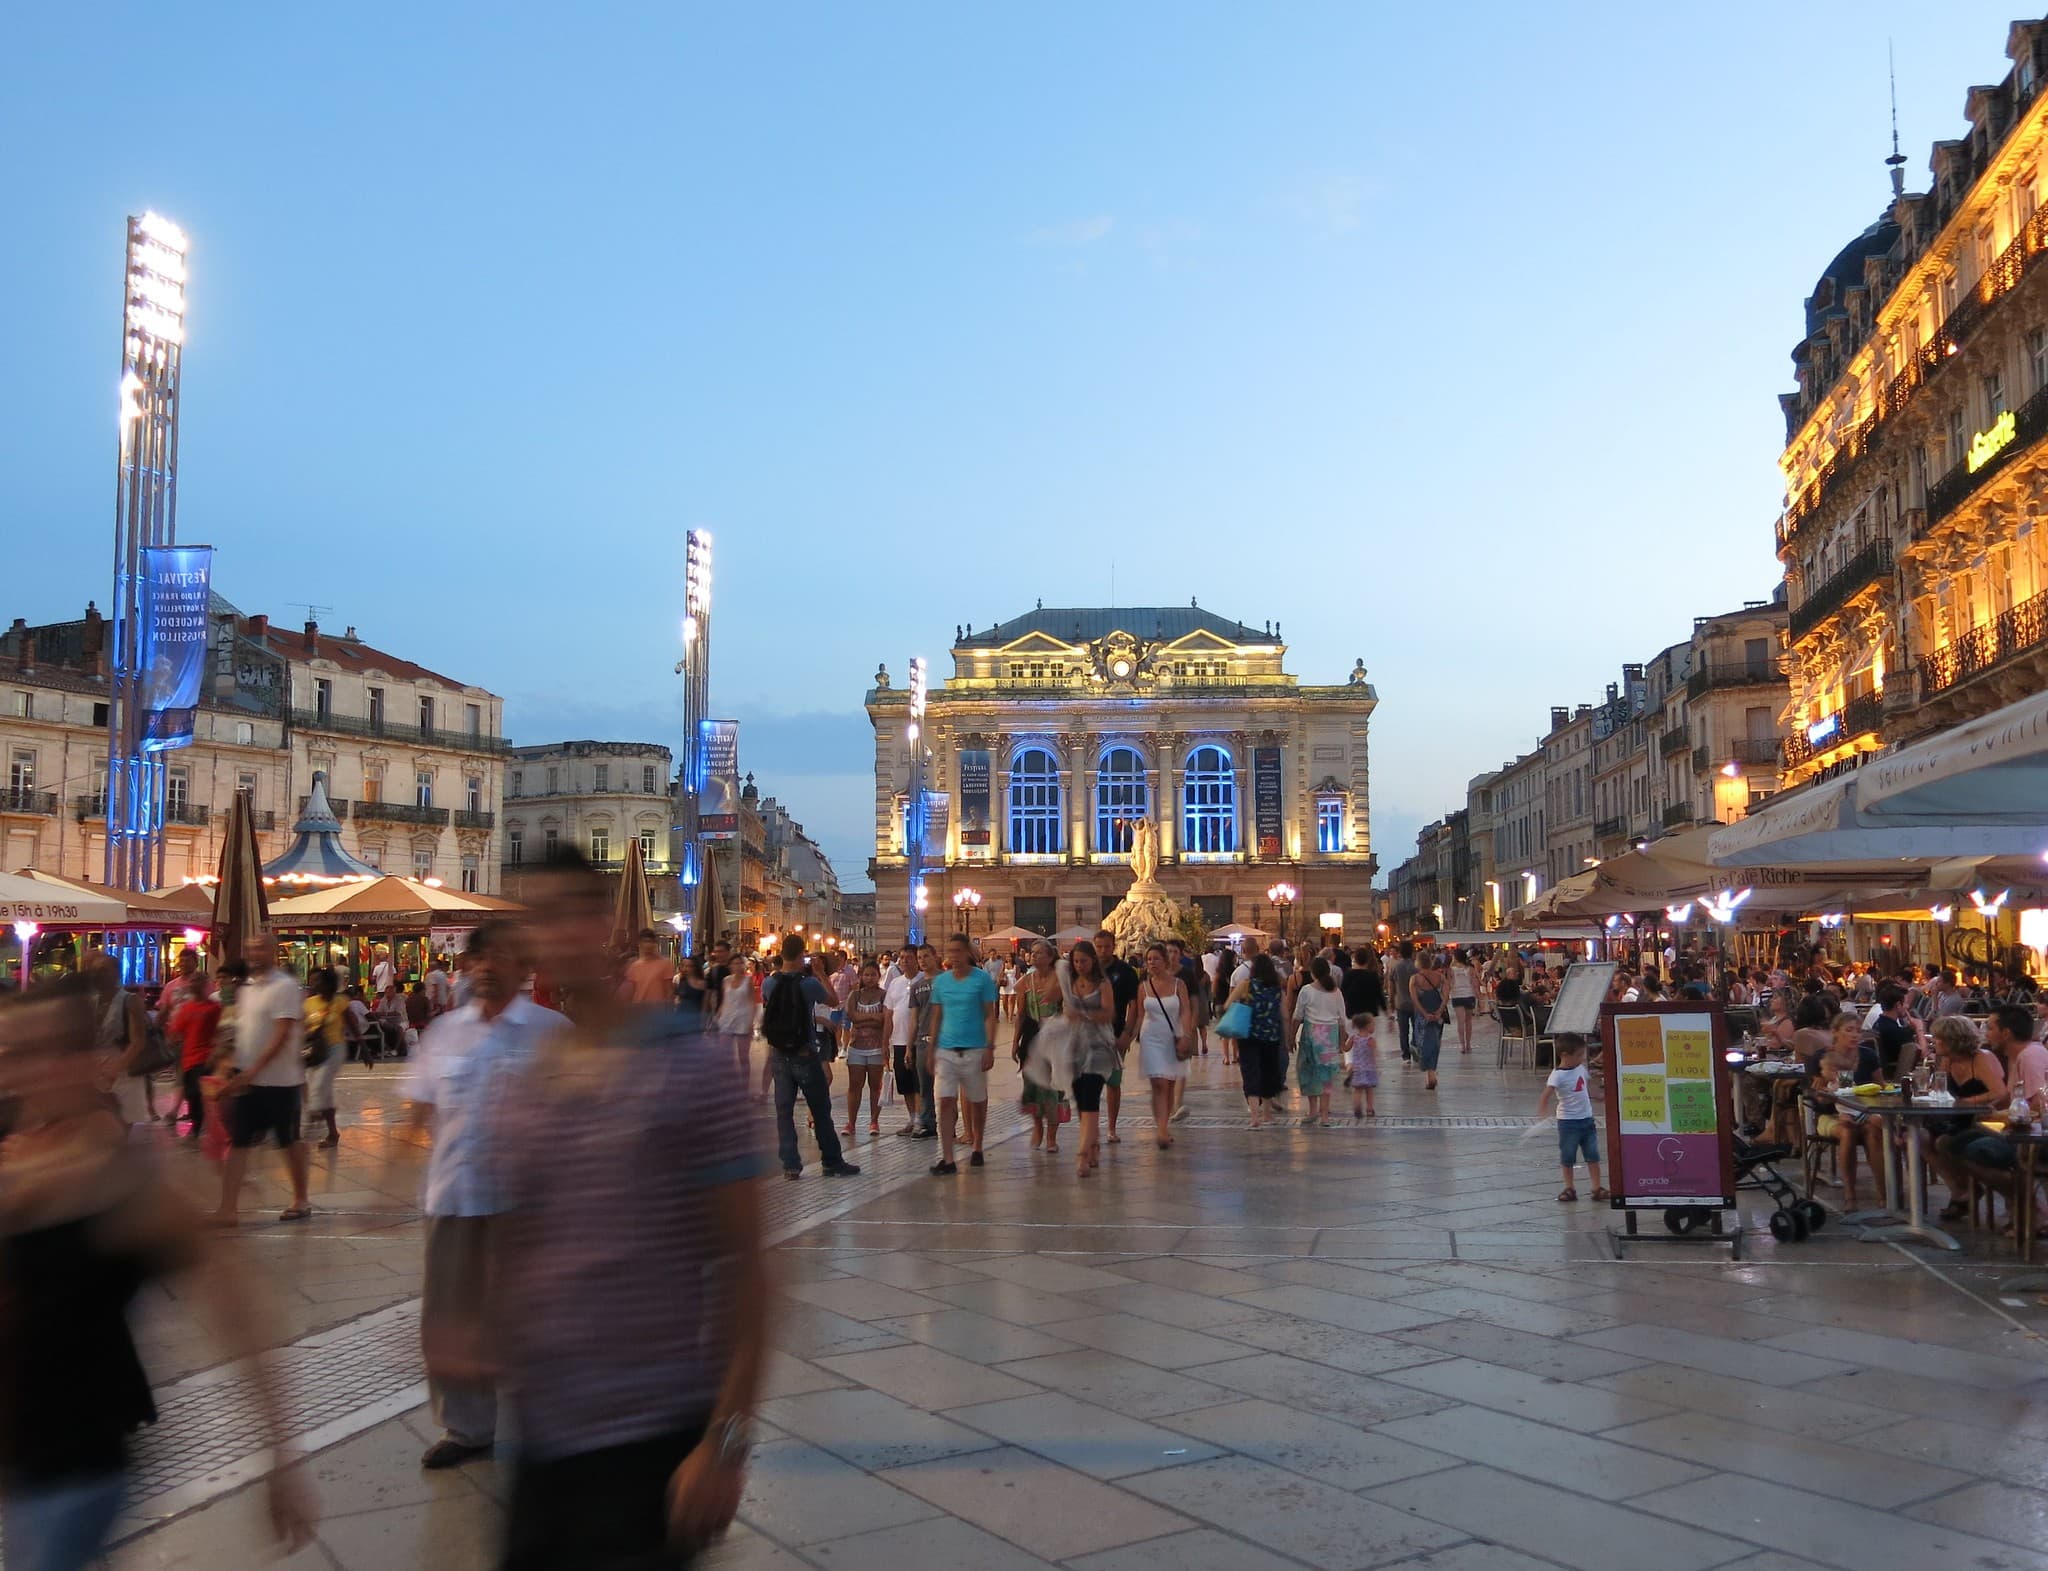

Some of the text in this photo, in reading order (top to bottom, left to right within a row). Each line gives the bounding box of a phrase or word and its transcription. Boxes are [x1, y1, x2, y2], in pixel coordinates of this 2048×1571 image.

[1760, 866, 1801, 884] Riche
[13, 904, 32, 917] 15h
[35, 904, 43, 917] à
[46, 905, 78, 918] 19h30
[368, 912, 411, 922] GRACES
[1638, 1177, 1670, 1187] grande
